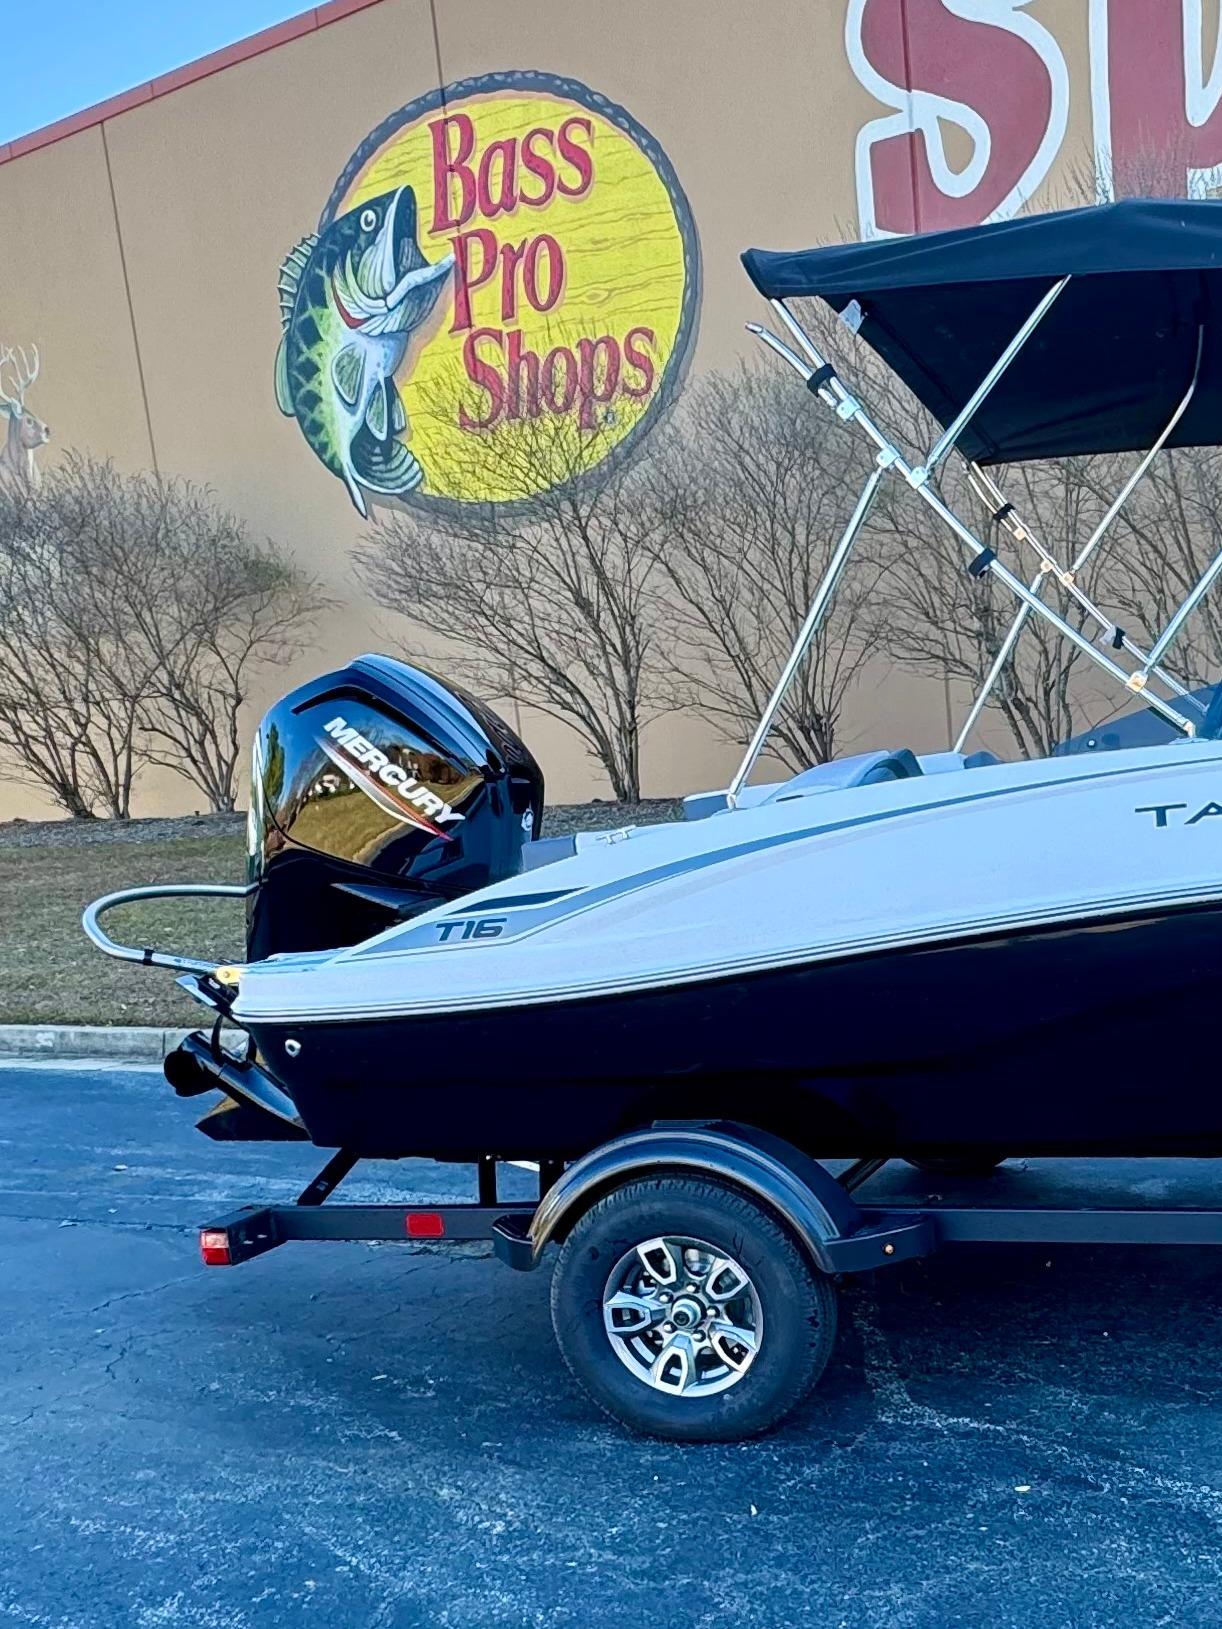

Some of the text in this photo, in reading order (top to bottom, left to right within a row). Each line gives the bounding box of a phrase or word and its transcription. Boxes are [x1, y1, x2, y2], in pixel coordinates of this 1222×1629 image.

[428, 113, 595, 234] Bass
[448, 227, 564, 334] Pro
[458, 325, 656, 432] Shops
[322, 716, 466, 824] MERCURY
[436, 918, 507, 942] T16
